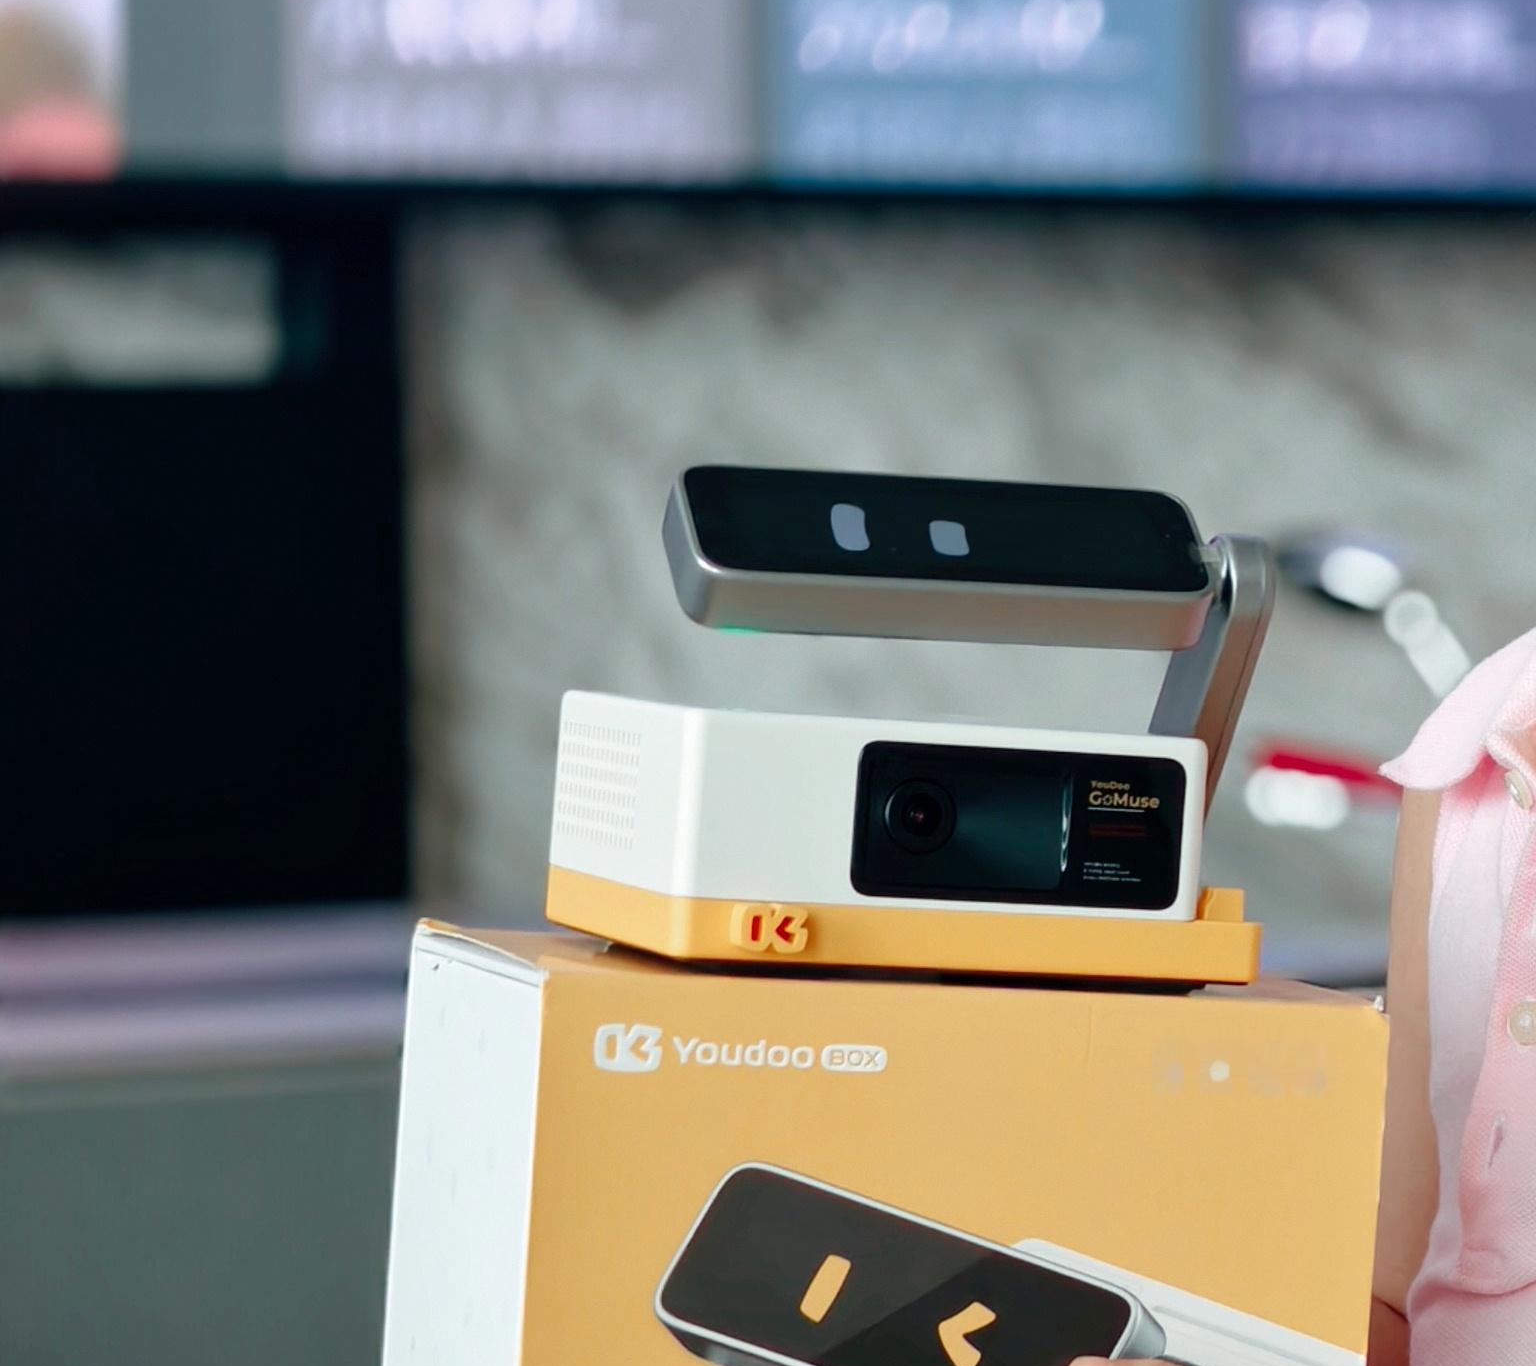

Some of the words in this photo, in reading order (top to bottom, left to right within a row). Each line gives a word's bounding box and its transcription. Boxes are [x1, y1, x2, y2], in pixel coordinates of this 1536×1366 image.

[1088, 791, 1160, 809] GoMuse
[672, 1035, 816, 1069] Youdoo
[825, 1047, 883, 1069] BOX
